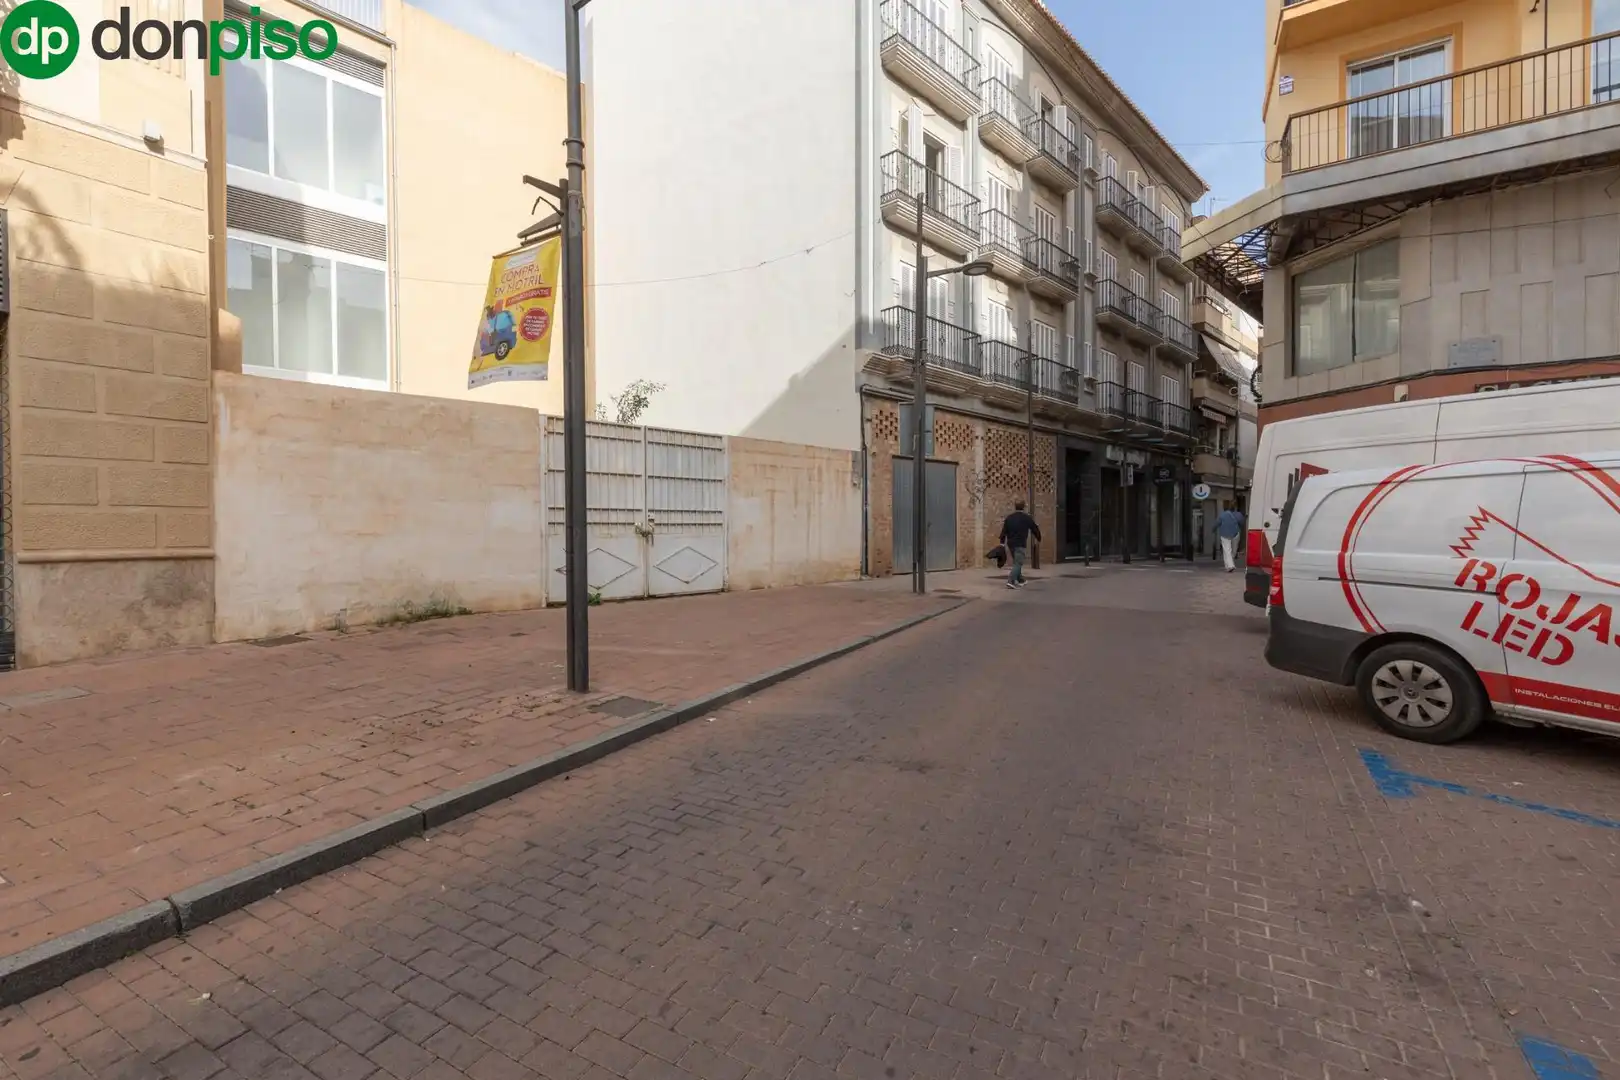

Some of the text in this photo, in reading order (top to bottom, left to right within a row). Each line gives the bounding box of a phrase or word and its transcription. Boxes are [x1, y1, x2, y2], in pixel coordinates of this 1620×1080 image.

[500, 263, 540, 284] COMPRA
[494, 274, 545, 298] EN MOTRIL
[1454, 558, 1620, 646] ROJA
[1460, 600, 1574, 666] LED
[1514, 688, 1620, 712] INSTALACIONES EL
